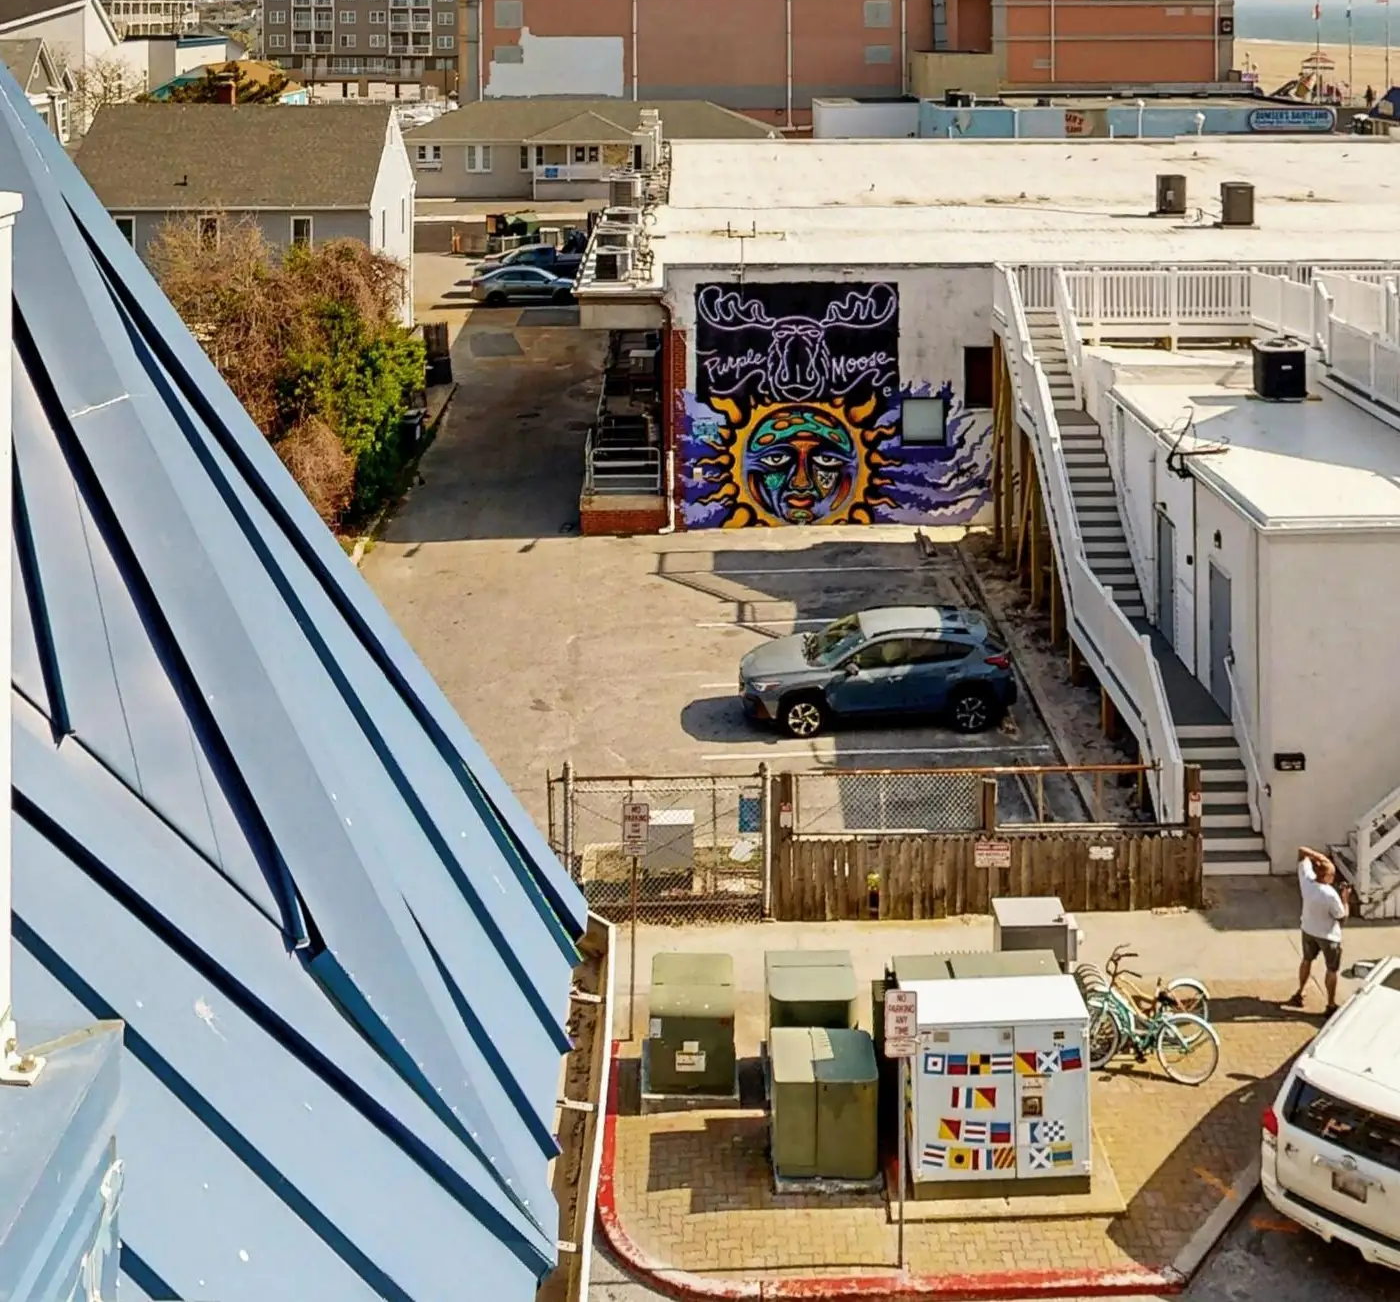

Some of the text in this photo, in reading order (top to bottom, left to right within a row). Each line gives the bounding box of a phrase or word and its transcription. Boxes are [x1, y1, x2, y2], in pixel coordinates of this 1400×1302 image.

[704, 348, 896, 383] Purple Moose
[897, 994, 907, 1002] NO
[888, 1004, 915, 1013] PARKING
[896, 1015, 908, 1024] ANY
[895, 1026, 909, 1035] TIME
